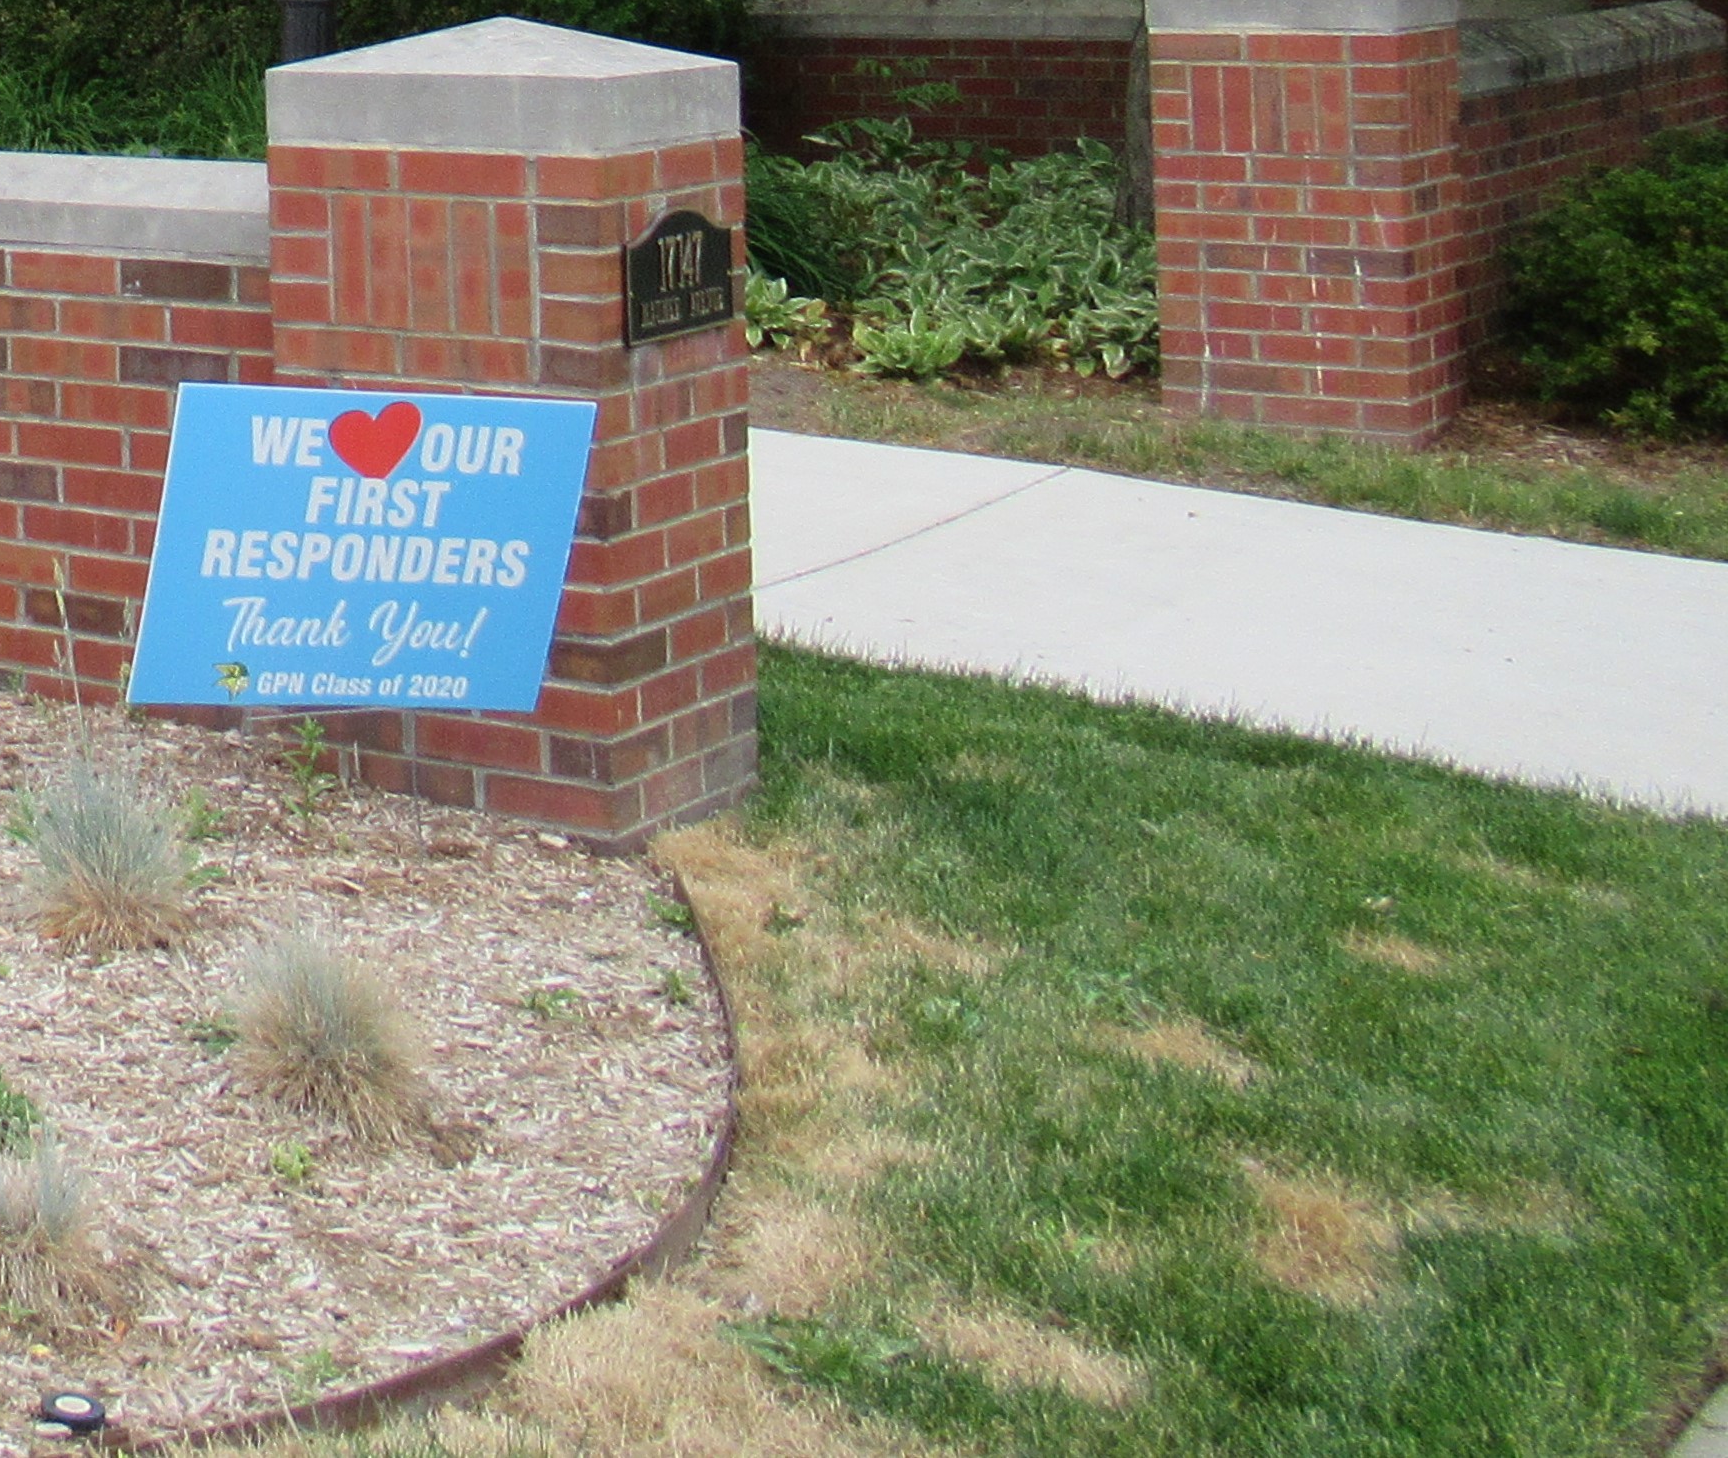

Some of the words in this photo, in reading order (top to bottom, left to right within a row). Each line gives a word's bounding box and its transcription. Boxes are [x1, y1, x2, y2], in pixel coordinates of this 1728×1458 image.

[658, 230, 703, 292] 17147
[250, 415, 329, 468] WE
[419, 423, 525, 476] OUR
[304, 476, 451, 529] FIRST
[199, 529, 531, 588] RESPONDERS
[222, 596, 348, 652] Thank
[368, 599, 489, 667] You!
[256, 671, 304, 695] GPN
[311, 672, 372, 696] Class
[378, 674, 404, 695] of
[408, 674, 469, 699] 2020
